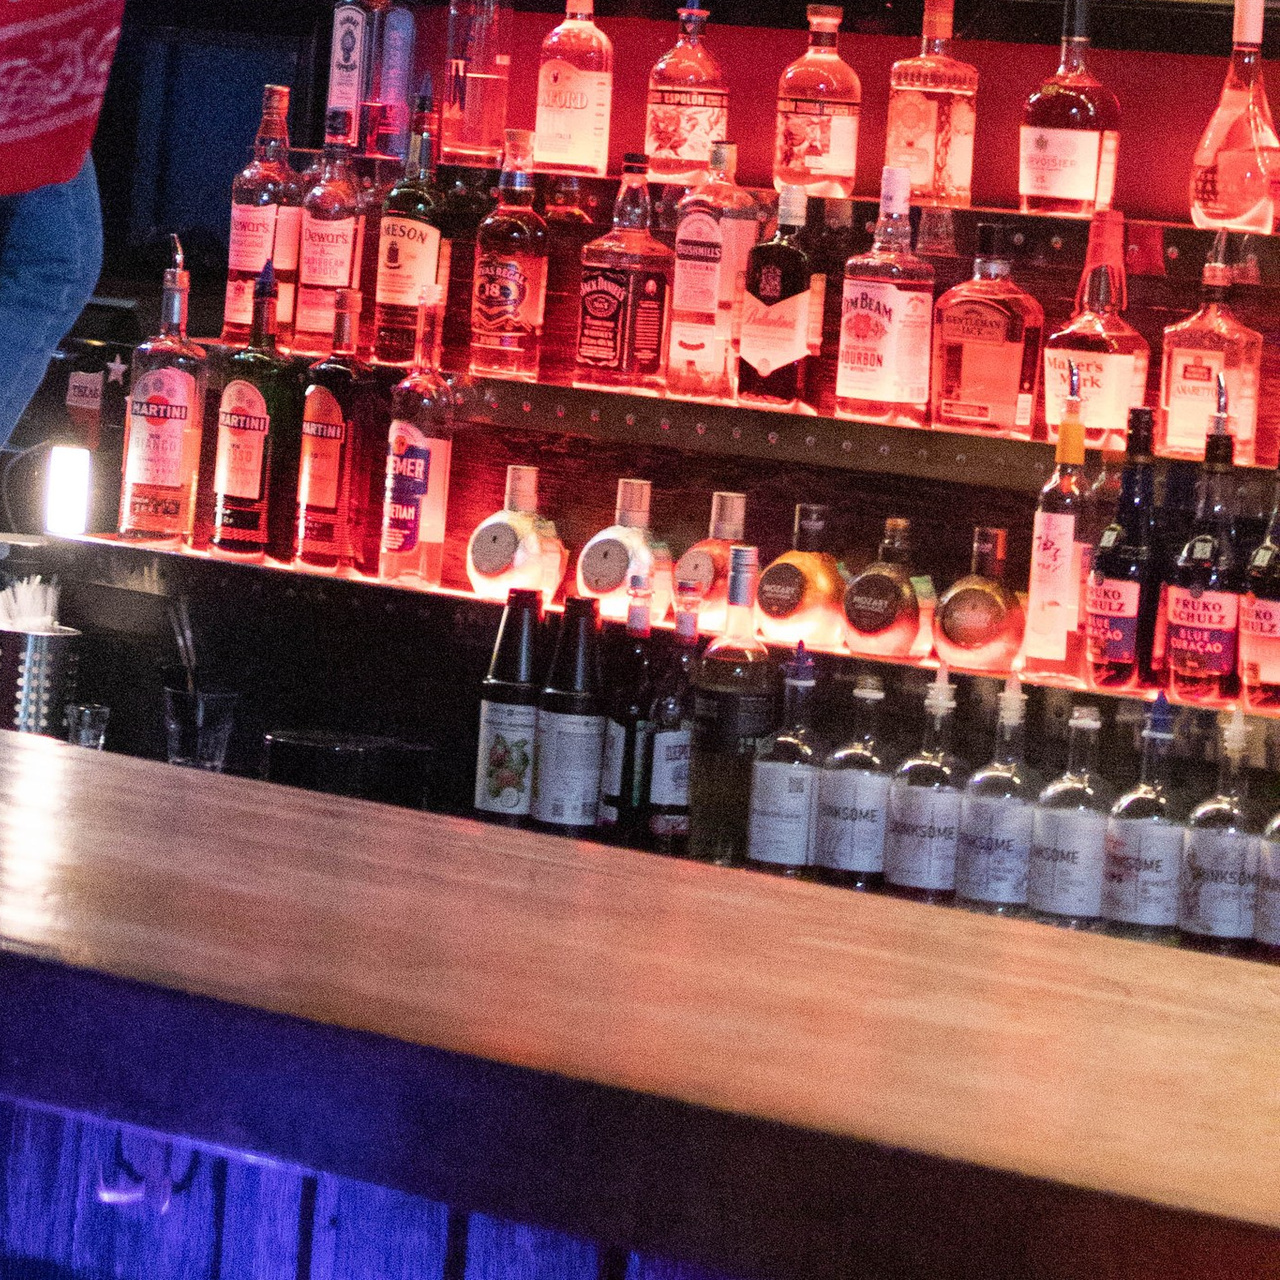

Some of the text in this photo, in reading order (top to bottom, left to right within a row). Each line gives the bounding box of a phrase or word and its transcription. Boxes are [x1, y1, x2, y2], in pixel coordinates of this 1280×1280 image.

[304, 226, 350, 245] Dewar's
[383, 223, 428, 245] MESON
[859, 291, 893, 323] BEAM
[1047, 356, 1104, 375] Maer's
[1059, 372, 1103, 390] Mrk
[131, 402, 187, 420] MARTINI
[1087, 598, 1126, 613] HULZ
[1173, 595, 1223, 613] FRUKO
[1172, 608, 1227, 626] SCHULZ
[1178, 627, 1211, 642] BLUE
